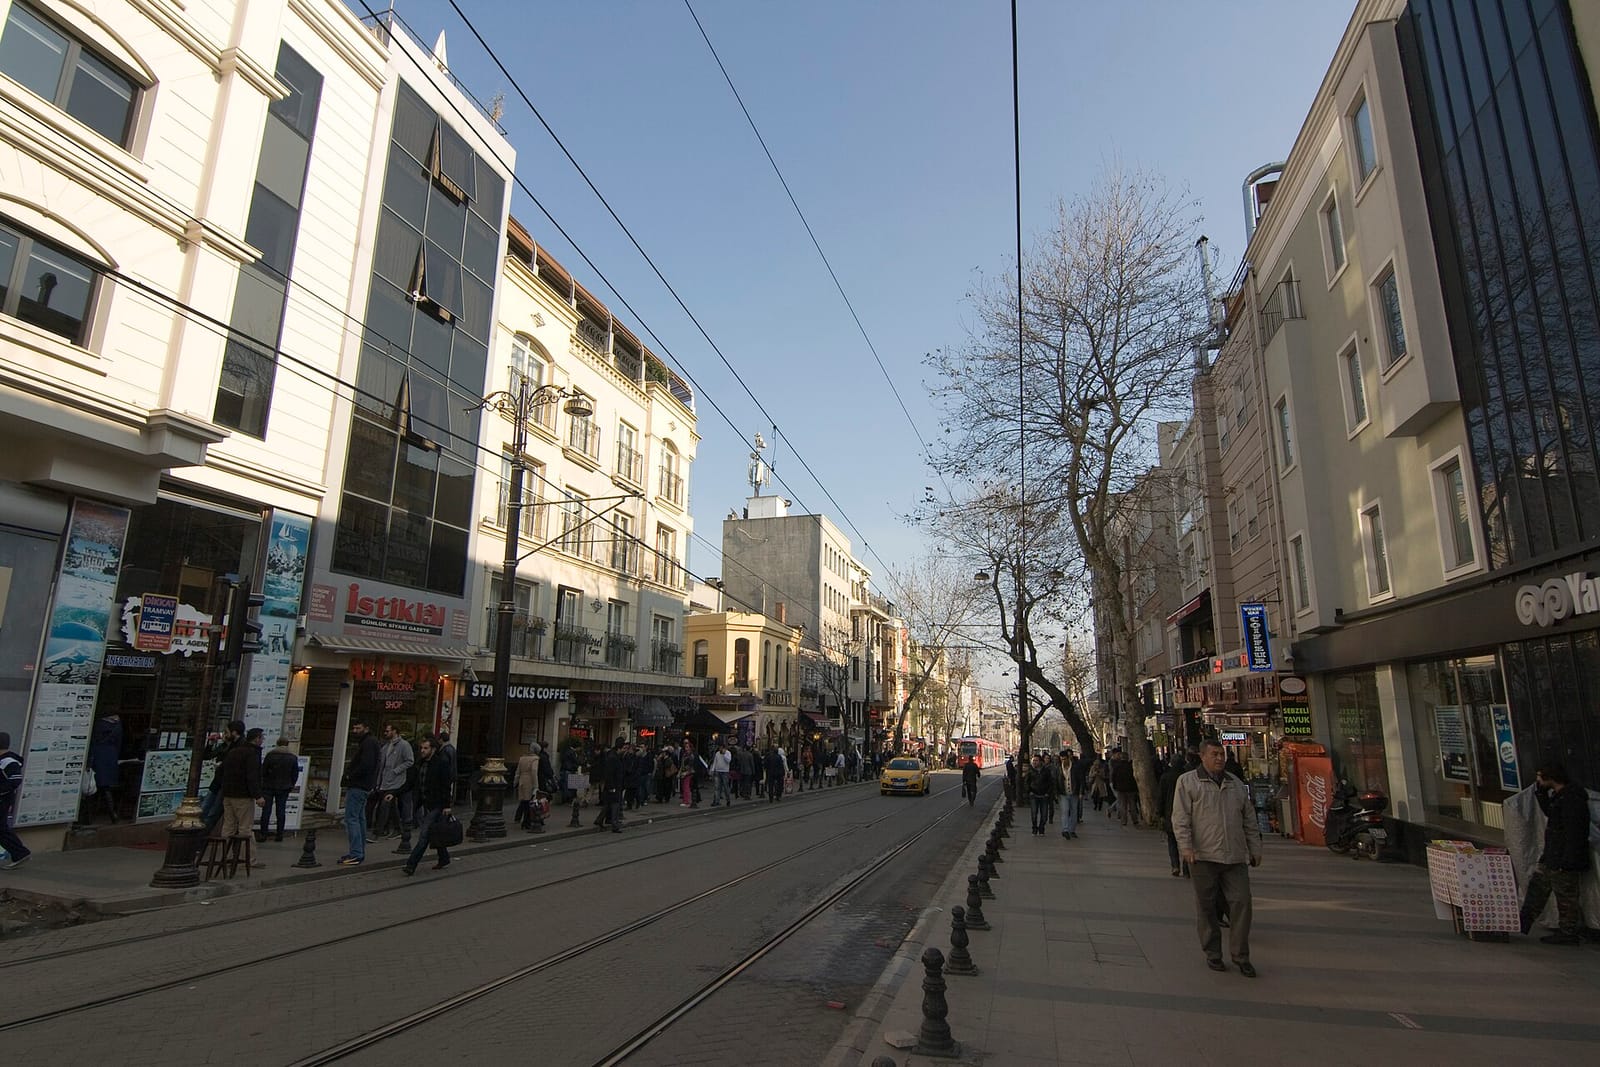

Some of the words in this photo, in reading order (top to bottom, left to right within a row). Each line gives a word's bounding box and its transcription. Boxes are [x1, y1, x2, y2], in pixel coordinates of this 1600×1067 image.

[1565, 571, 1600, 615] Ya
[143, 606, 175, 616] TRAMVAY
[361, 618, 388, 629] GÜNLÜK
[186, 640, 209, 648] AGENC
[107, 655, 155, 668] INFORMATION
[471, 683, 535, 700] STAUCKS
[537, 687, 570, 700] COFFEE
[384, 701, 404, 710] SHOP
[1283, 716, 1311, 724] TAVUK
[1285, 726, 1312, 735] DÖNER
